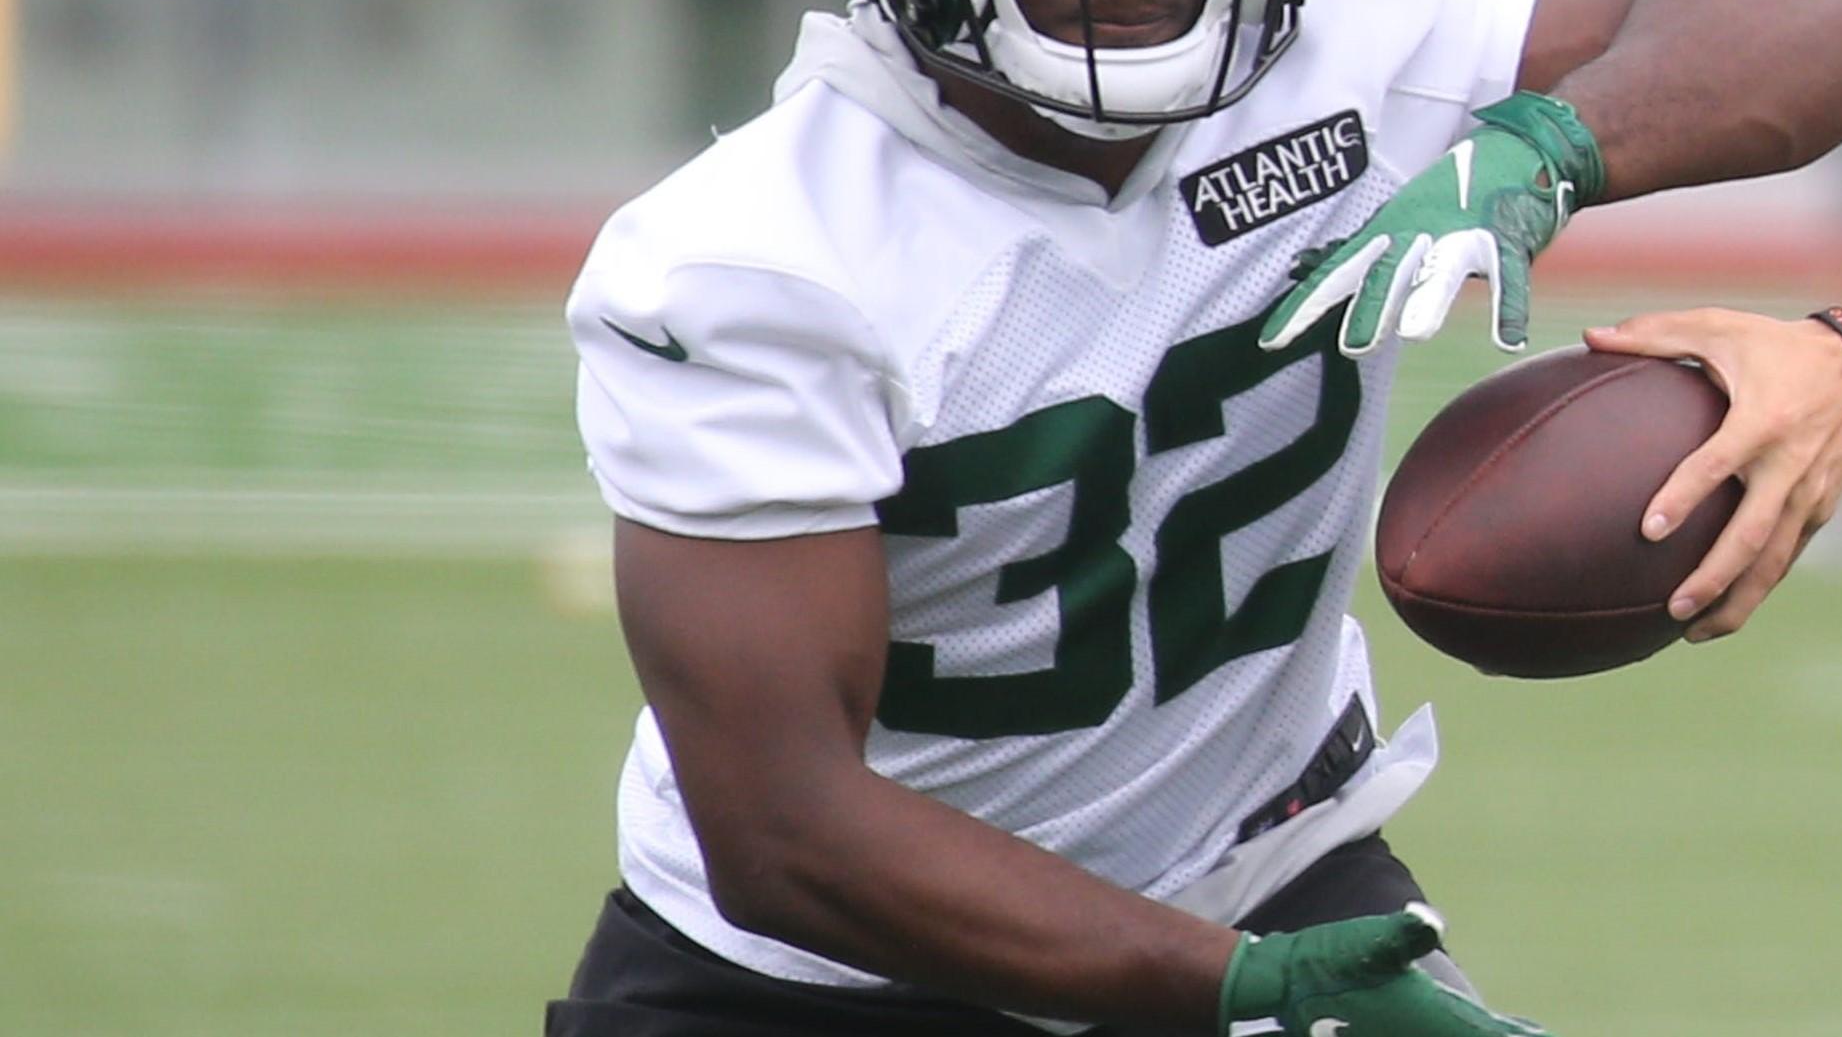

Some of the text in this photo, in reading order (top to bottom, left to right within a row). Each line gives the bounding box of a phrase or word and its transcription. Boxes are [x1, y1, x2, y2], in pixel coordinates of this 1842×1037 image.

[1195, 117, 1362, 212] ATLANTIC
[1220, 152, 1349, 231] HEALTH
[875, 286, 1362, 740] 32
